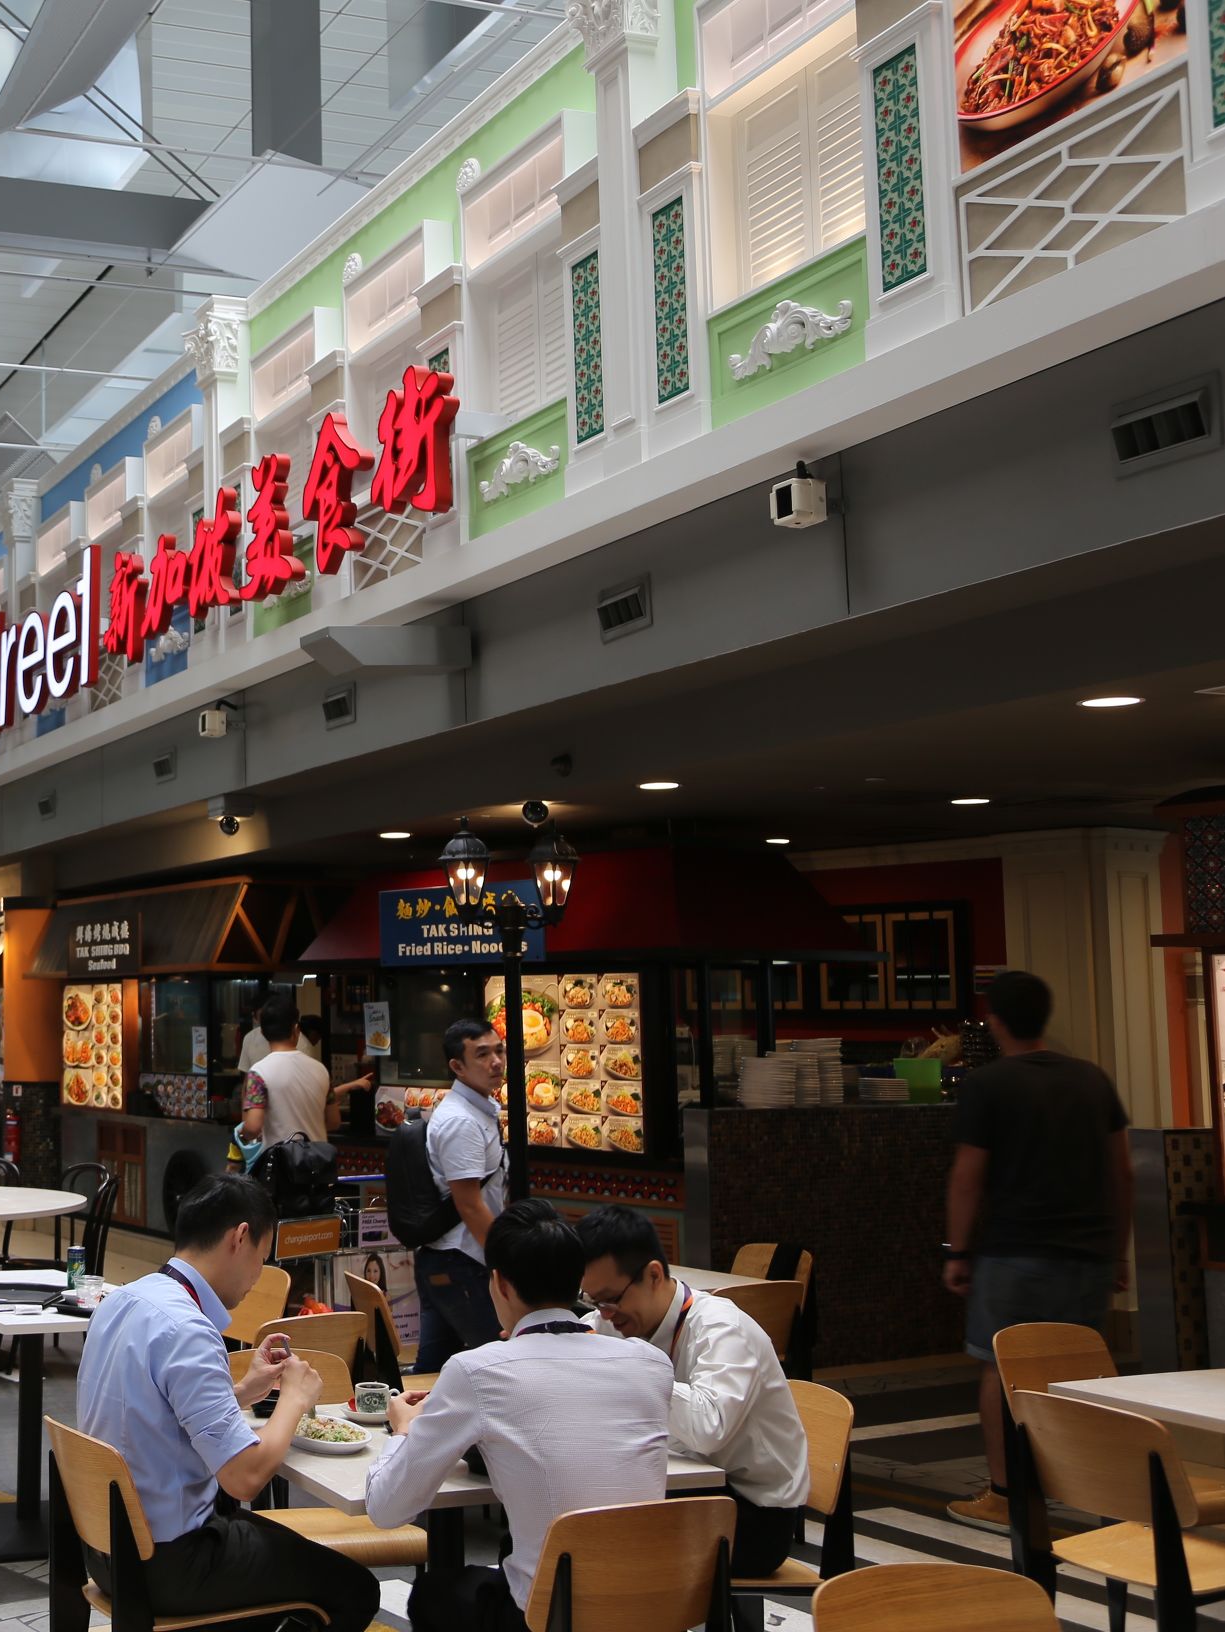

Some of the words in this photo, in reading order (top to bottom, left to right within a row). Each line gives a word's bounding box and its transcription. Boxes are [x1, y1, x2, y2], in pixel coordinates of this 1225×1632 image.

[104, 364, 460, 663] 新加坡美食街
[421, 923, 448, 938] TAK
[449, 921, 494, 937] SHING
[76, 946, 90, 958] TAK
[91, 944, 114, 957] SHING
[114, 943, 130, 956] BBQ
[398, 942, 432, 957] Fried
[88, 957, 117, 971] Seafood
[284, 1231, 334, 1245] changiairport.com
